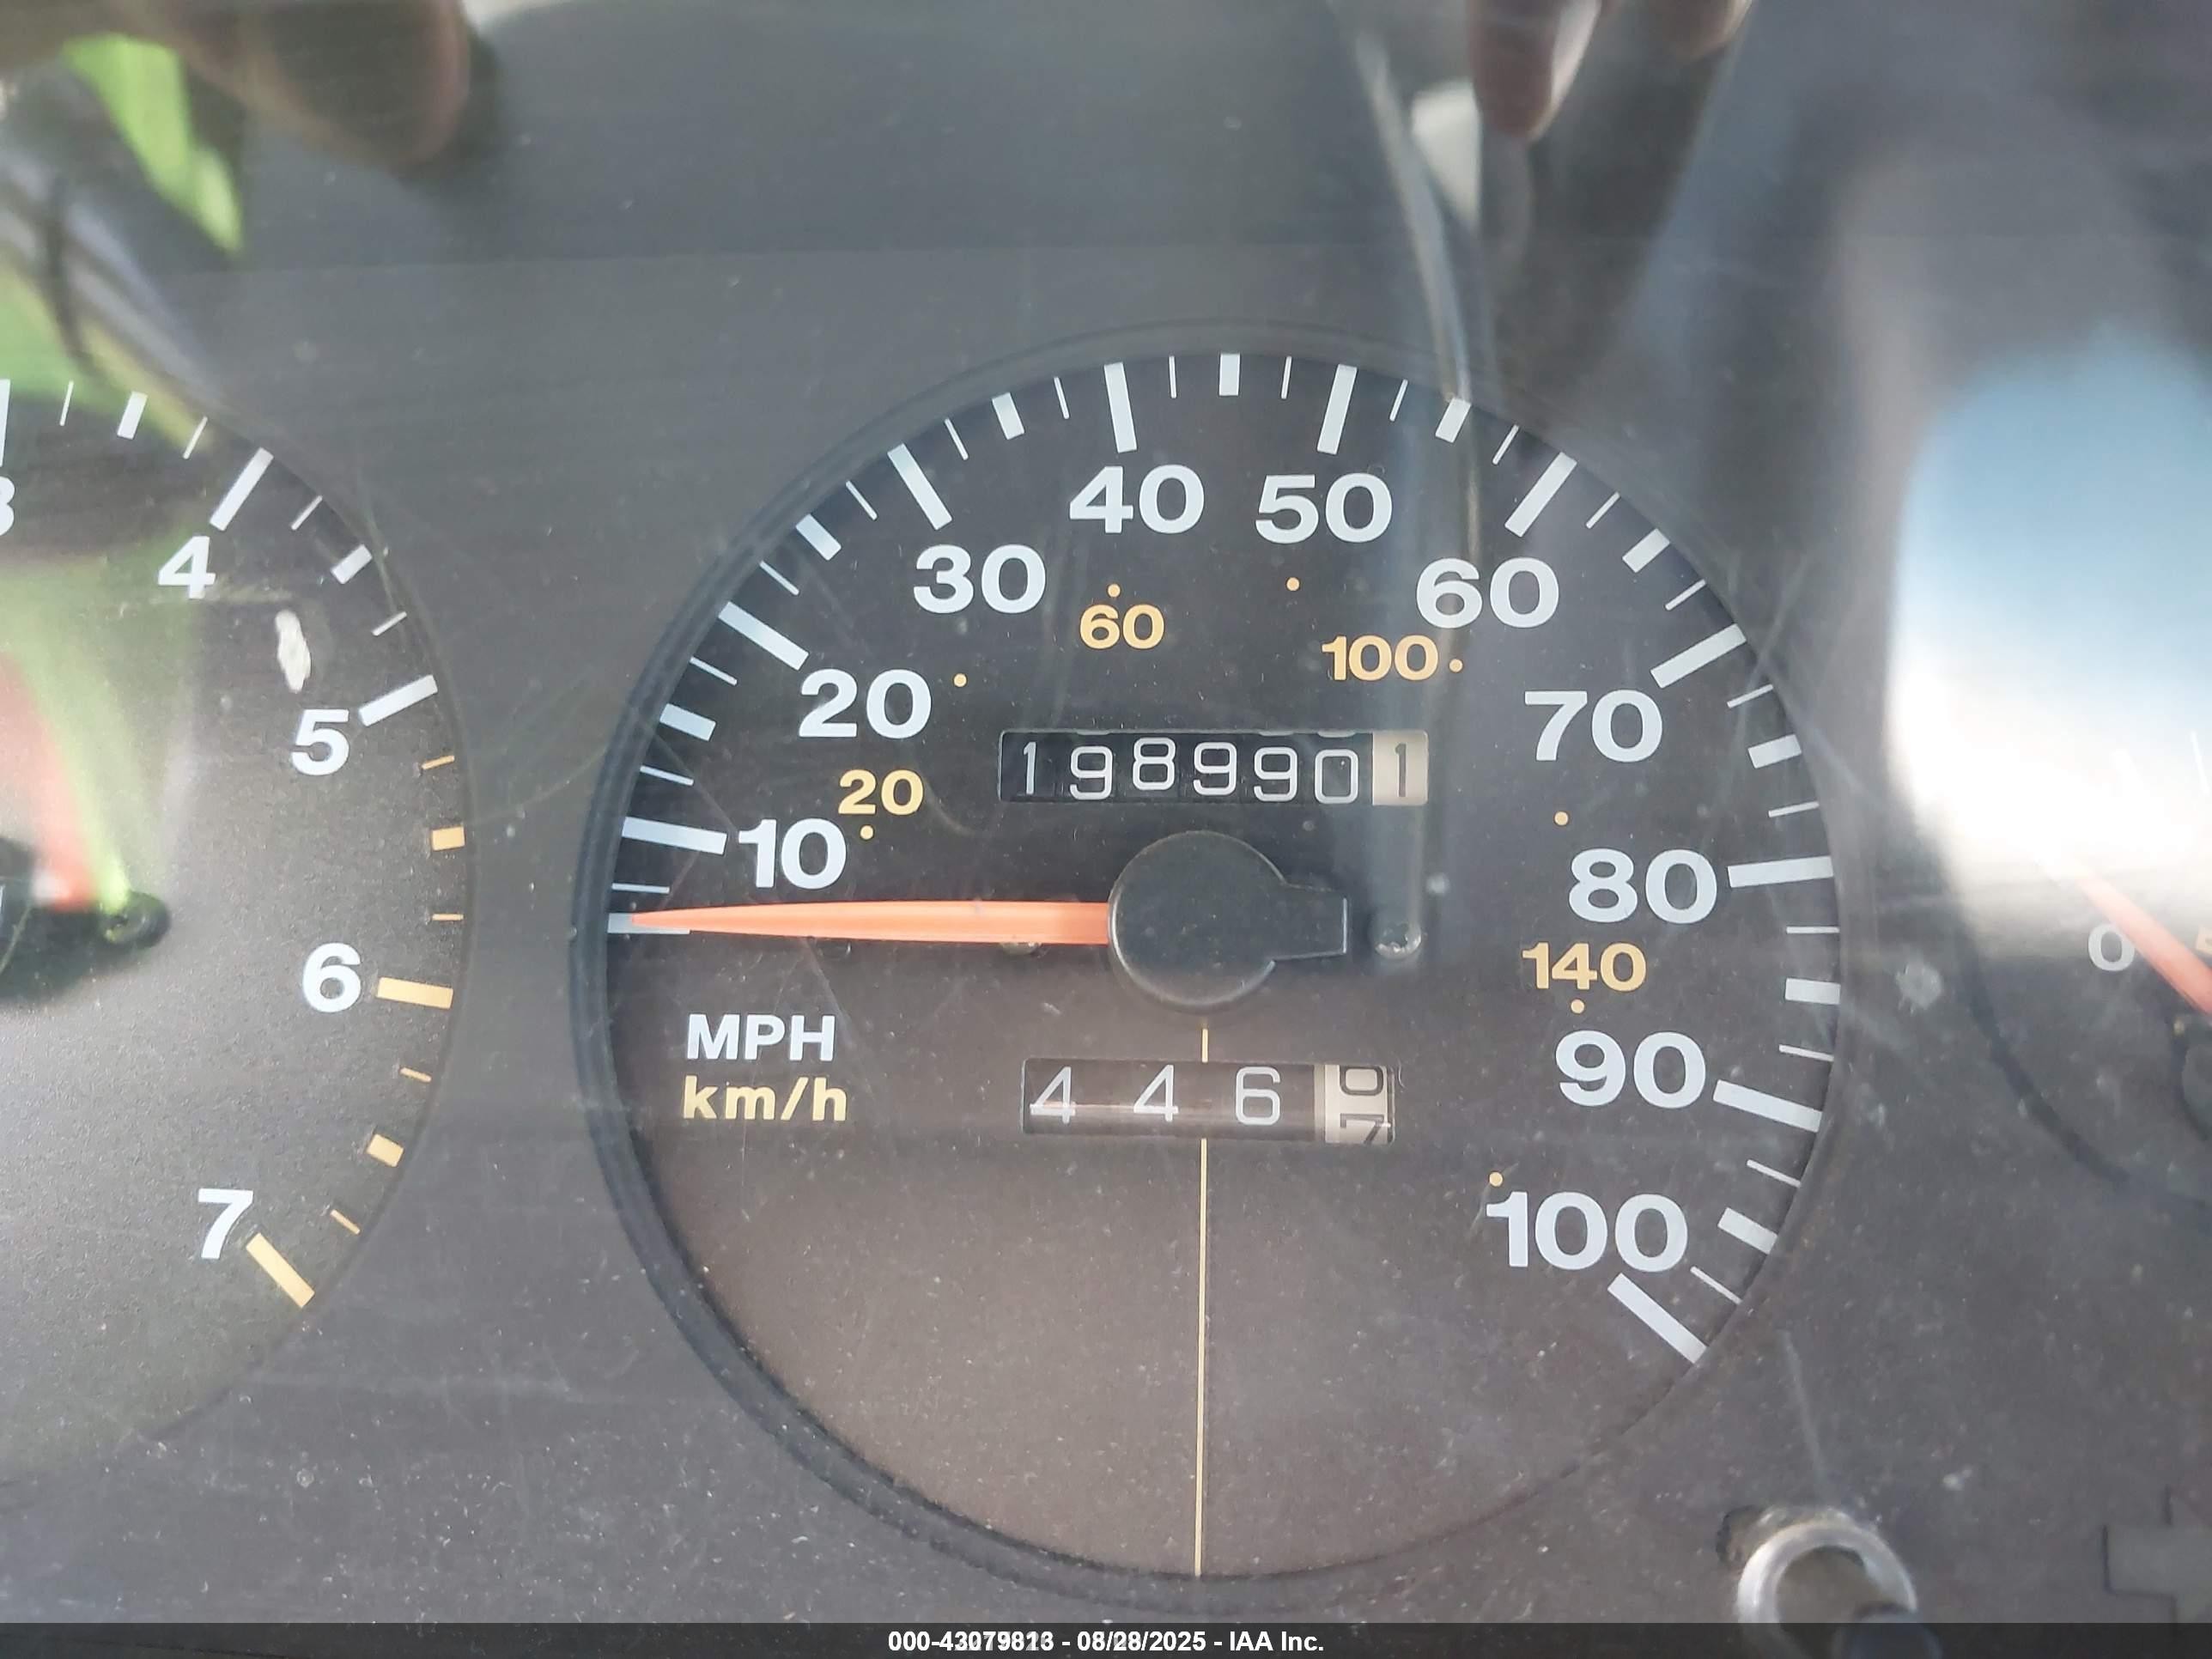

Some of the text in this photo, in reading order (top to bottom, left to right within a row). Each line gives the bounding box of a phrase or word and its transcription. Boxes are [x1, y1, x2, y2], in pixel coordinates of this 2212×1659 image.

[1070, 465, 1204, 533] 40
[1255, 473, 1392, 544] 50
[158, 537, 216, 599] 4
[914, 544, 1045, 613] 30
[1417, 558, 1559, 629] 60
[1080, 605, 1164, 648] 60
[1322, 635, 1438, 680] 100
[799, 669, 931, 738] 20
[1525, 690, 1662, 762] 70
[291, 709, 349, 775] 5
[838, 769, 923, 815] 20
[738, 818, 846, 889] 10
[1569, 848, 1717, 923] 80
[302, 943, 361, 1012] 6
[1522, 943, 1646, 991] 140
[2088, 924, 2136, 971] 0
[687, 1014, 835, 1060] MPH
[1556, 1030, 1705, 1108] 90
[684, 1076, 846, 1121] km/h
[198, 1188, 253, 1259] 7
[1486, 1192, 1687, 1272] 100
